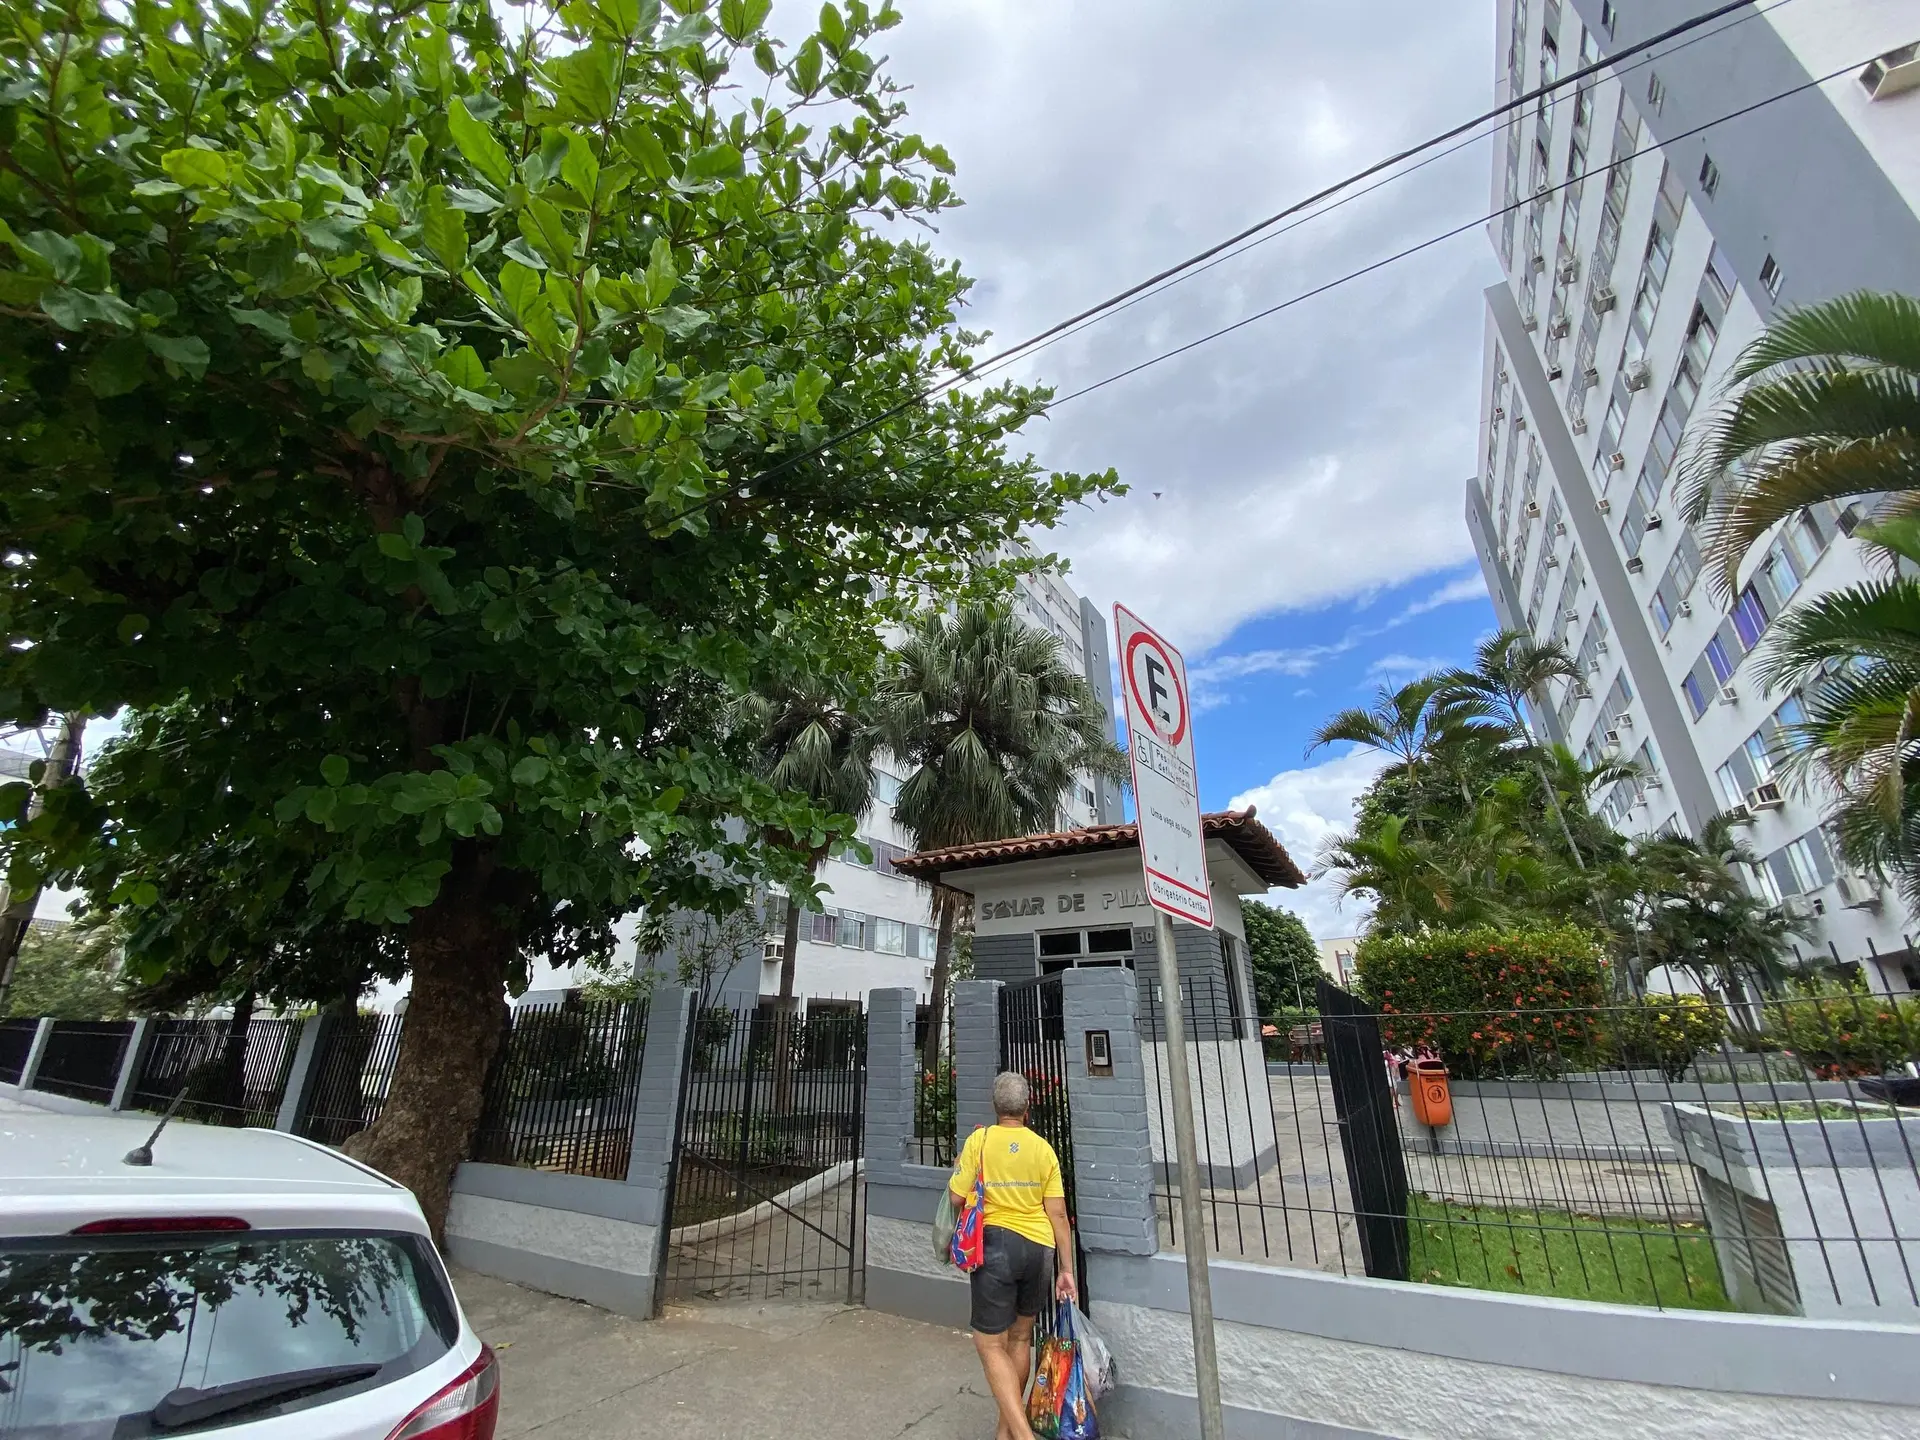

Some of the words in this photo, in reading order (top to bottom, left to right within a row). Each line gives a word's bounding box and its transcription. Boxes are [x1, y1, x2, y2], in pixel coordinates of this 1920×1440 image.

[1145, 653, 1171, 723] E
[1150, 806, 1162, 820] Uma
[1057, 893, 1085, 913] DE
[1102, 888, 1150, 909] PILA
[1153, 881, 1188, 904] Obrigatório
[1188, 897, 1206, 913] Cartão
